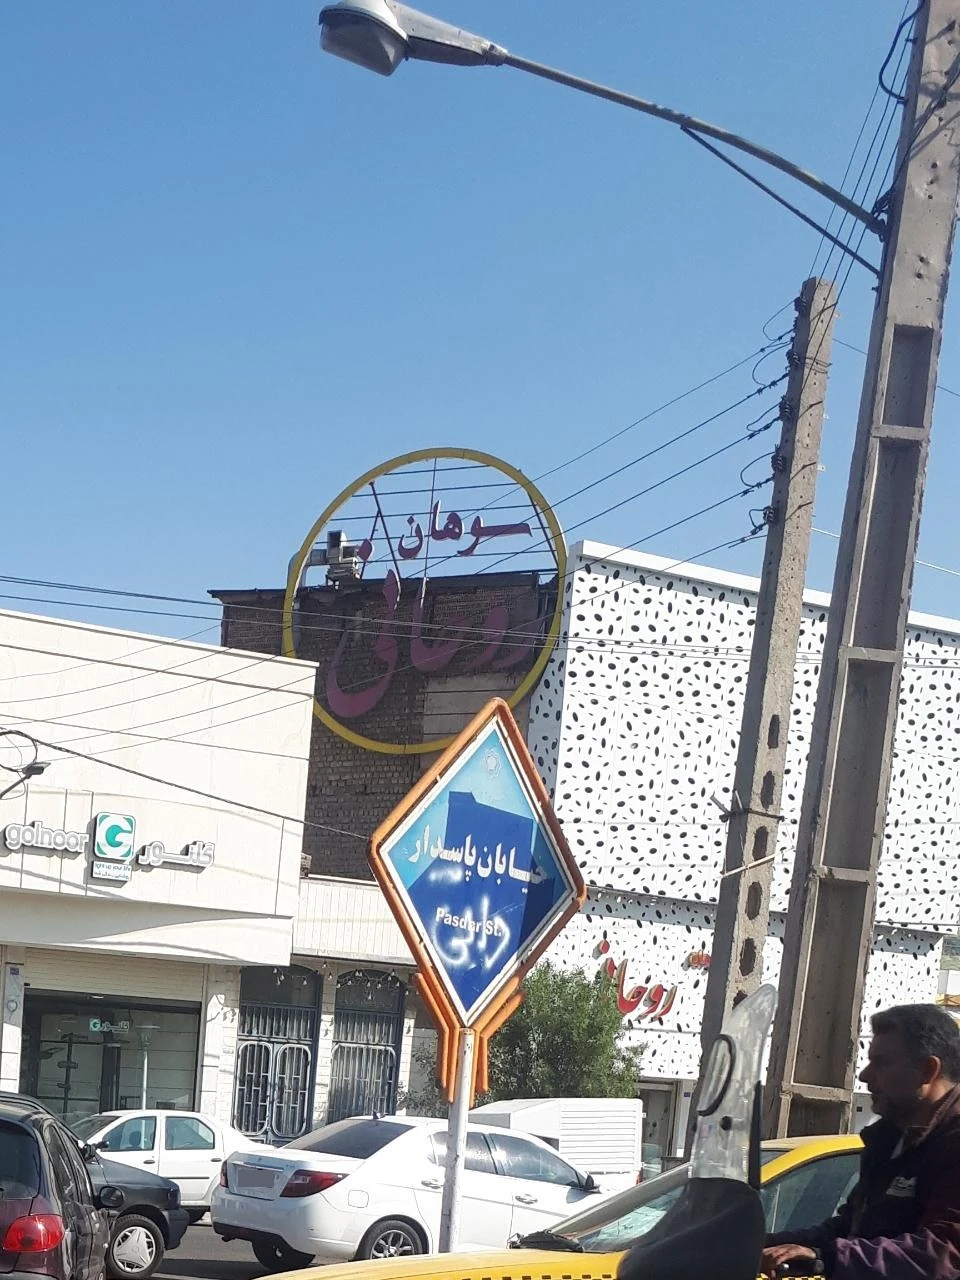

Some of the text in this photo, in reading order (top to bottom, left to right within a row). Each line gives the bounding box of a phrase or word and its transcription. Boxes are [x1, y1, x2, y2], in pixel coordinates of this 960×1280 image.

[398, 500, 533, 560] سوهان
[5, 821, 90, 851] golnoor
[139, 841, 215, 868] گلنور
[408, 825, 477, 882] پاسدار
